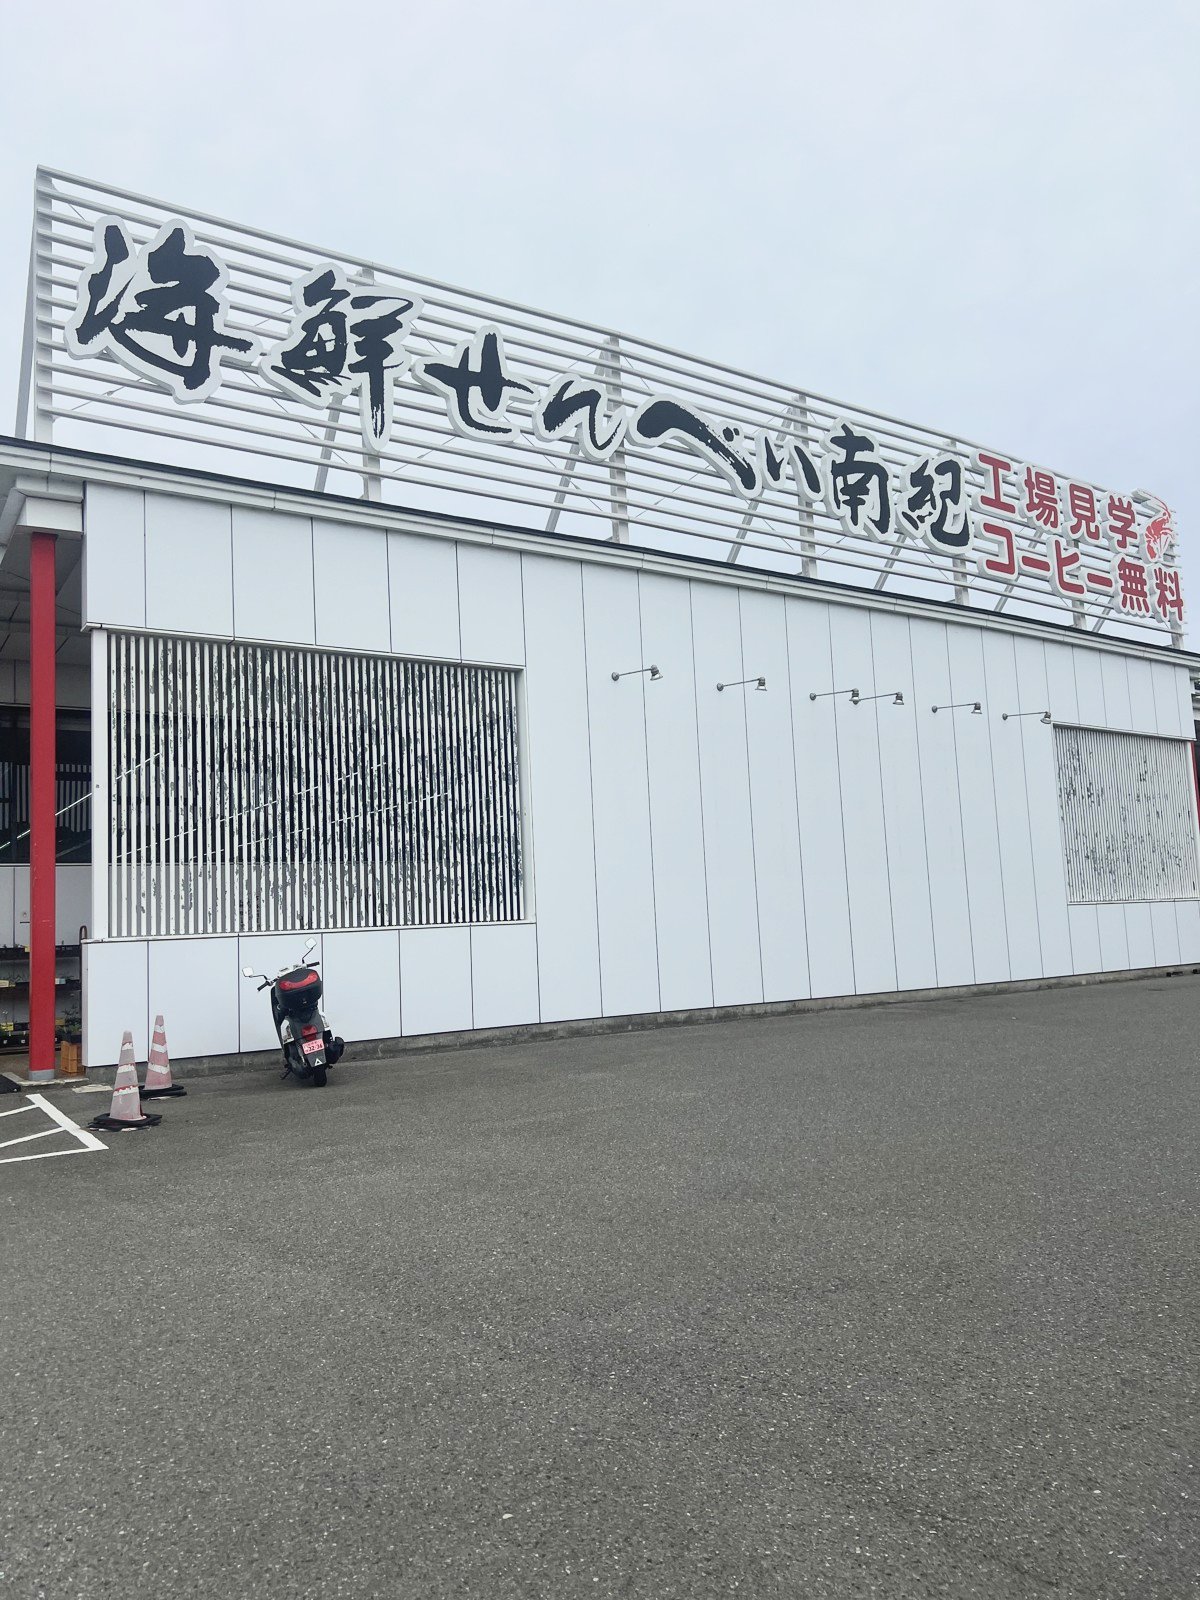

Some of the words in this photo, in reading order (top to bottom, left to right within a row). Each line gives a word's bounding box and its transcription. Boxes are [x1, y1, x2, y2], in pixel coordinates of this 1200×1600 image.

[75, 224, 971, 548] 海鮮せんべい南紀
[978, 452, 1138, 549] 工場見学
[982, 522, 1184, 622] コーヒー無料
